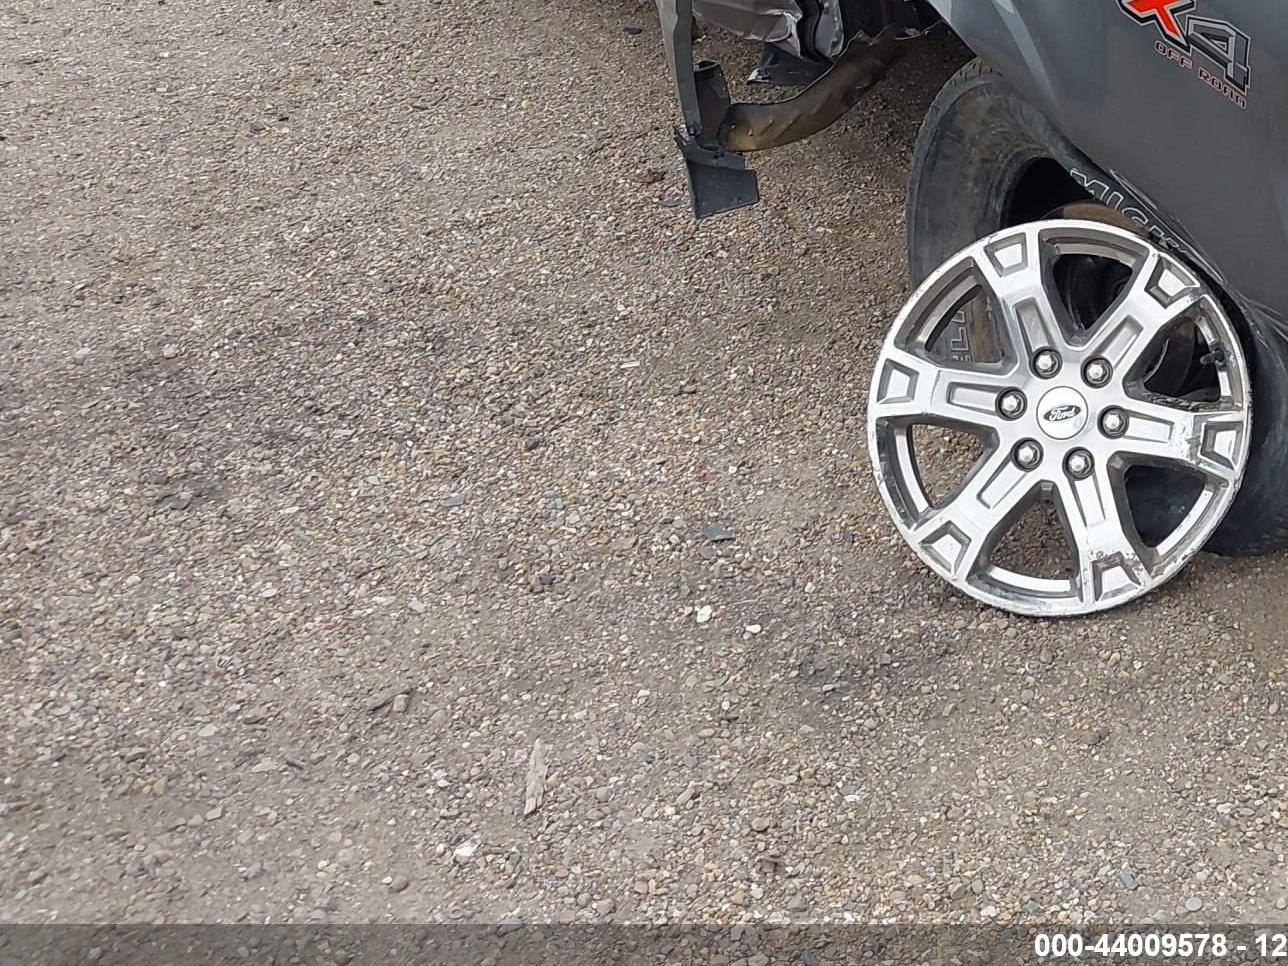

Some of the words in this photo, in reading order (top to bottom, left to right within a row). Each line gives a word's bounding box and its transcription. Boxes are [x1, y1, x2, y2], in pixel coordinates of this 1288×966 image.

[1155, 40, 1193, 70] OFF
[1198, 66, 1247, 109] ROAD
[1049, 406, 1077, 422] Ford
